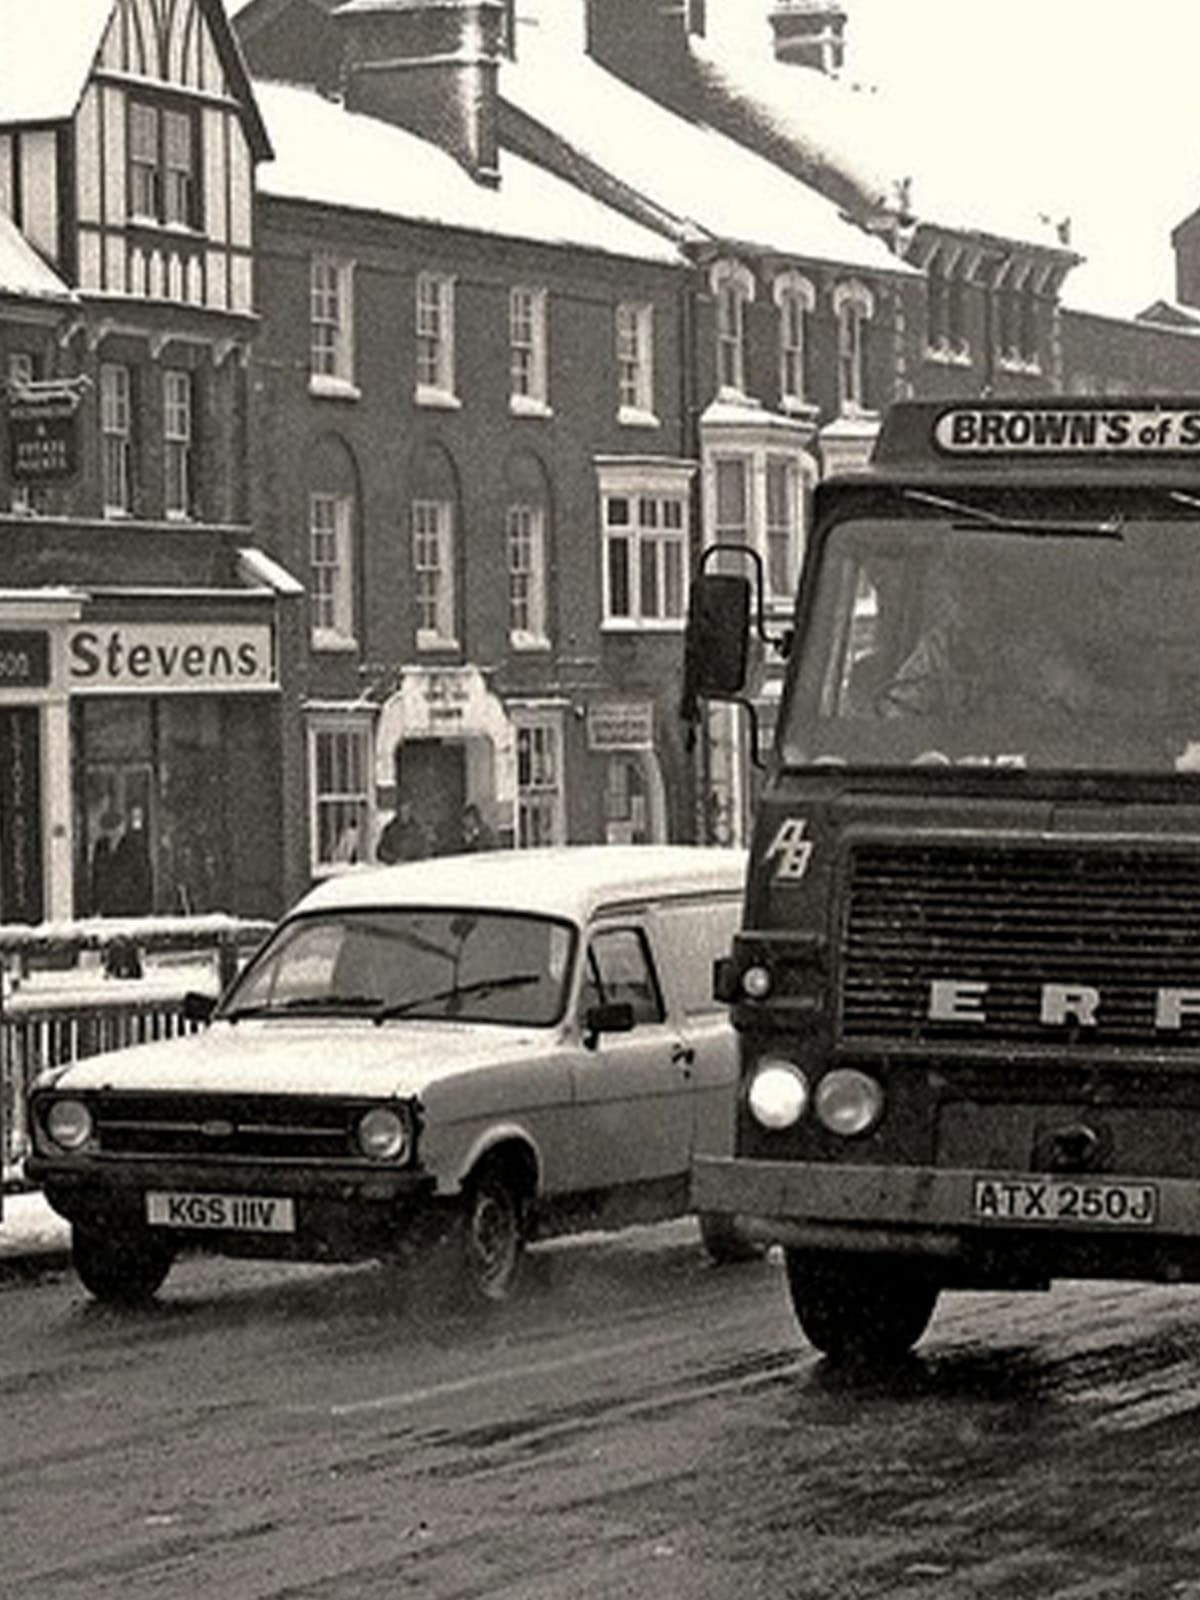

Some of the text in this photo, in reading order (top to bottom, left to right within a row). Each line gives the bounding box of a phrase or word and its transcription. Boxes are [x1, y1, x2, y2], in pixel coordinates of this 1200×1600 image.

[951, 413, 1131, 447] BROWN'S
[1139, 418, 1171, 447] of
[69, 631, 258, 679] Stevens
[168, 1198, 226, 1224] KGS
[978, 1185, 1151, 1220] ATX 250J
